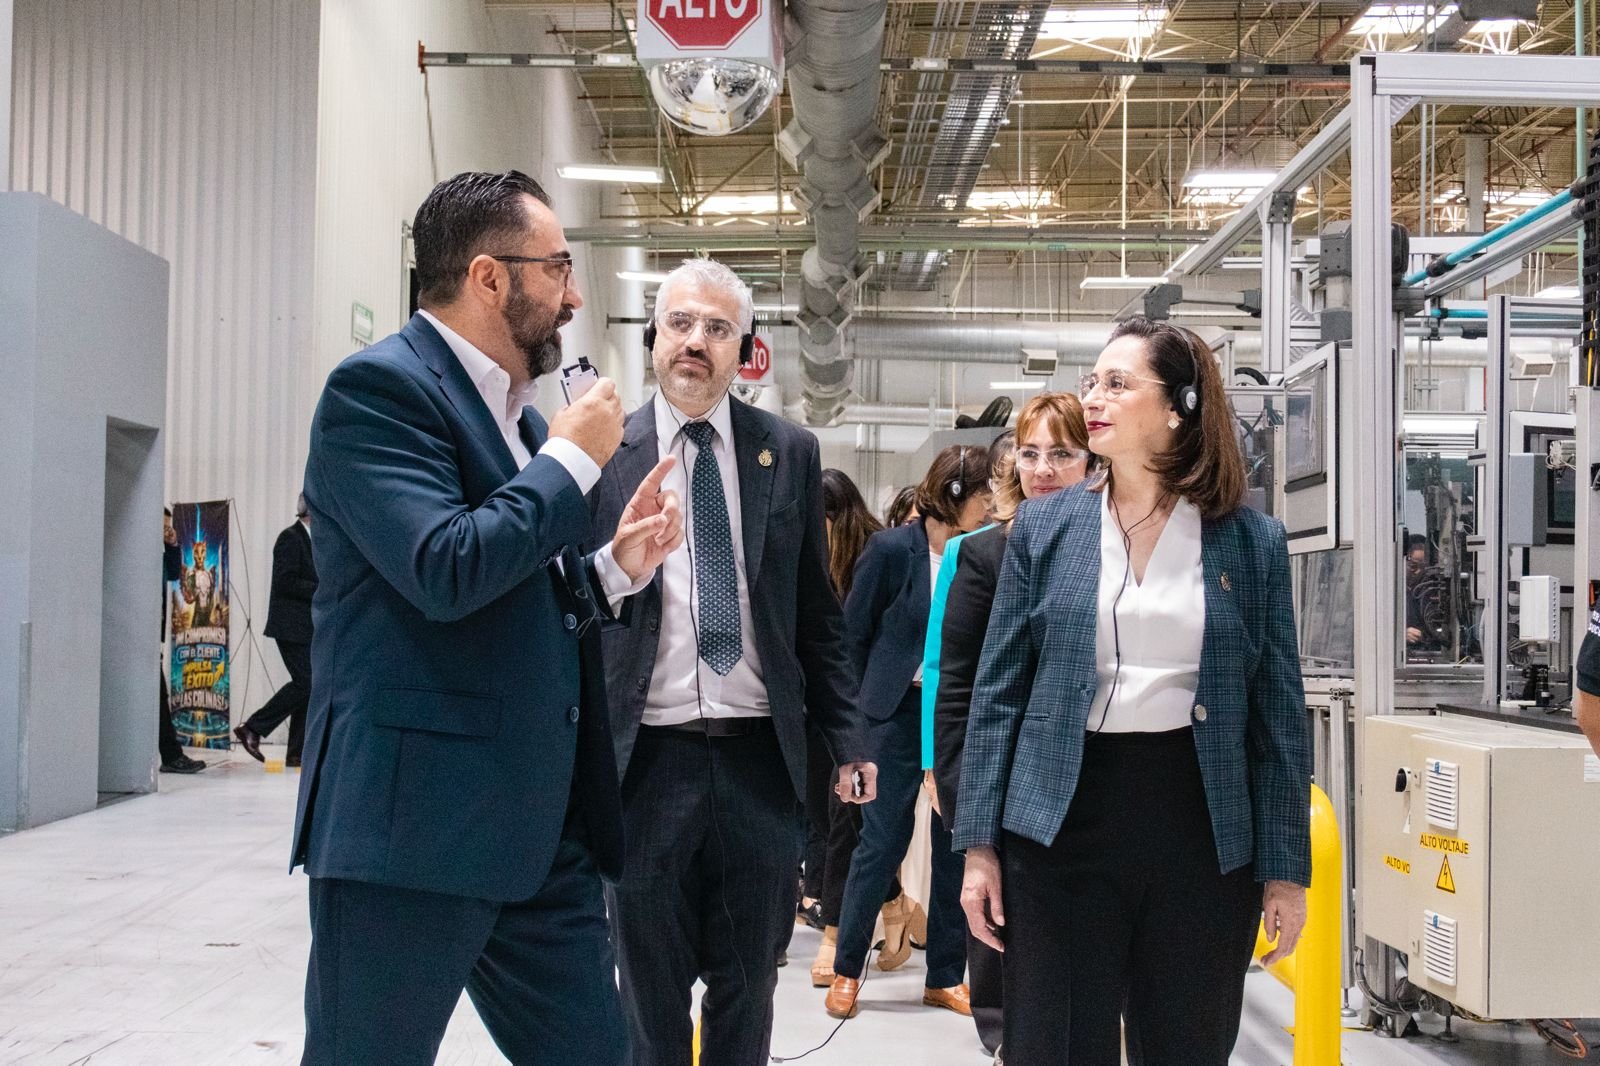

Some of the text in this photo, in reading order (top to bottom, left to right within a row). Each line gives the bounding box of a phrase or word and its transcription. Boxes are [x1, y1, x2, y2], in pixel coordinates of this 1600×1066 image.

[742, 347, 767, 371] TO
[197, 647, 220, 658] CLIENTE
[1420, 834, 1469, 854] ALTO VOLTAJE
[1386, 856, 1401, 870] ALTO
